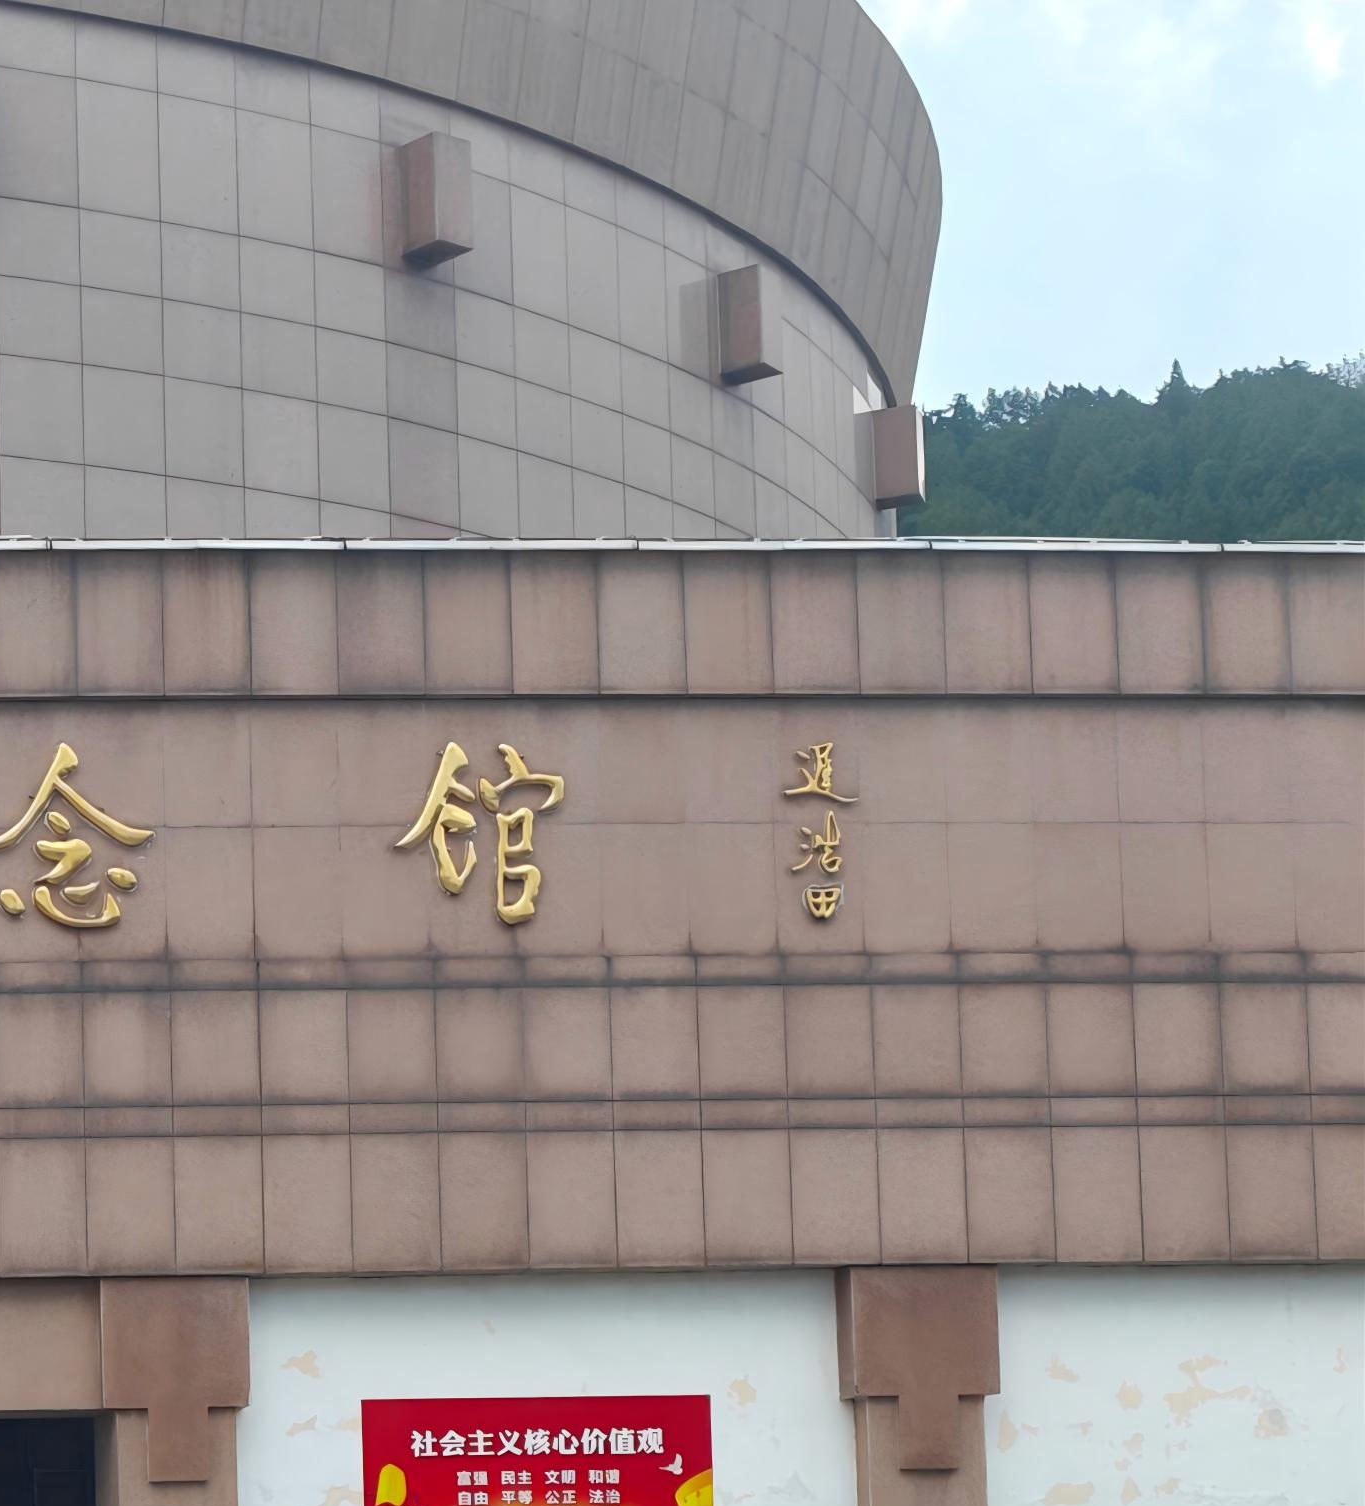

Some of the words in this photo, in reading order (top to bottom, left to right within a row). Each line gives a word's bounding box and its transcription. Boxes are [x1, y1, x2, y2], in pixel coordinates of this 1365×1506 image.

[410, 1427, 665, 1458] 社会主义核心价值观
[500, 1470, 533, 1485] 民主
[544, 1469, 576, 1485] 文明
[588, 1468, 620, 1484] 和谐
[457, 1491, 489, 1506] 自由
[501, 1490, 533, 1505] 平等
[545, 1489, 577, 1505] 公正
[589, 1488, 621, 1504] 法治
